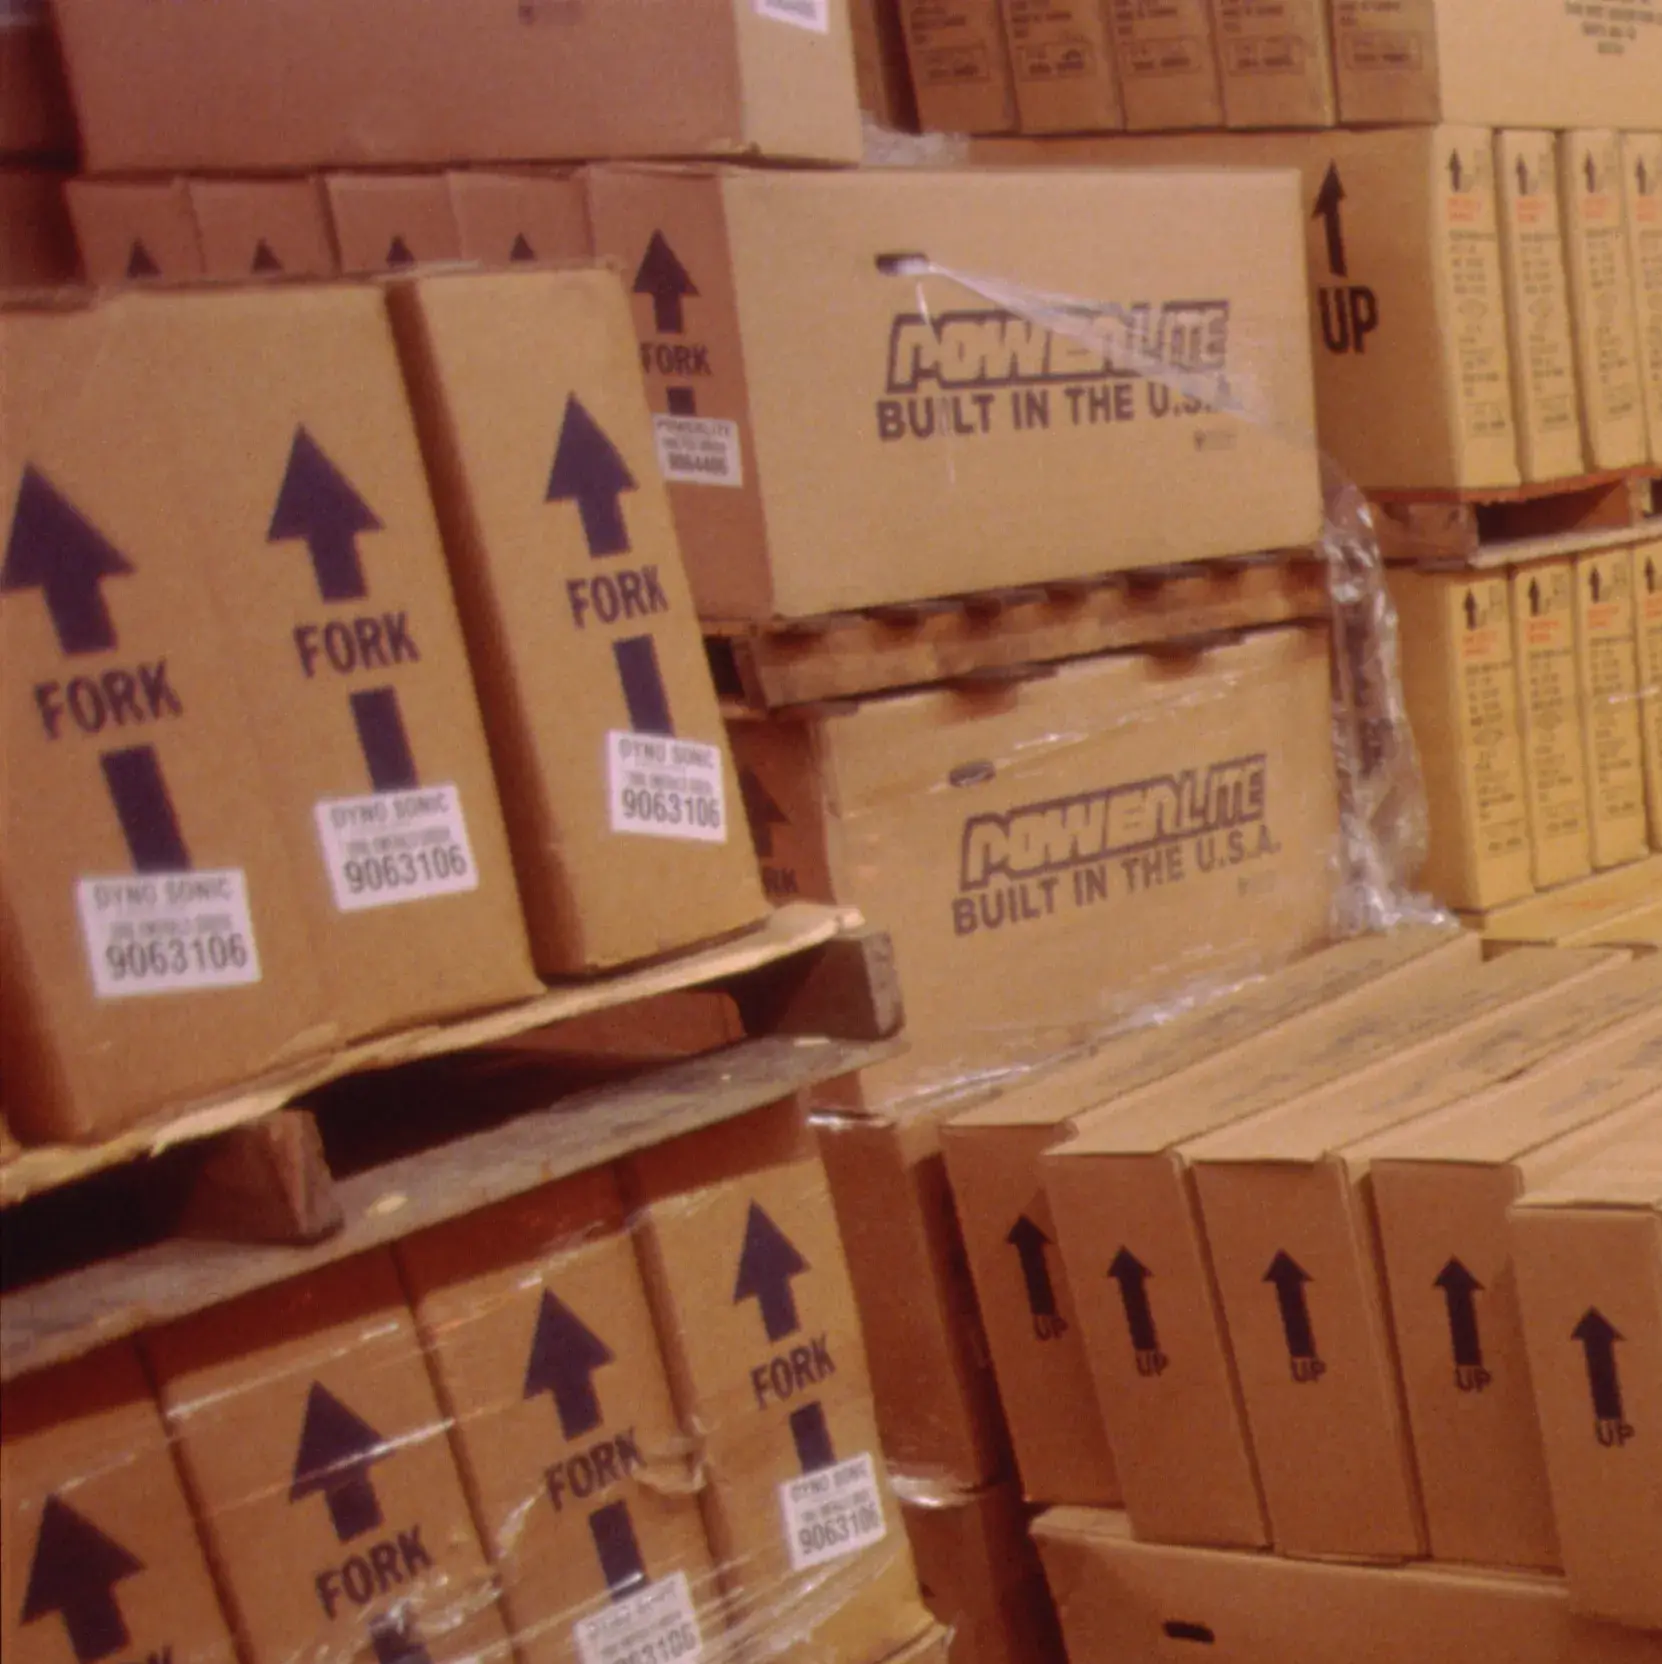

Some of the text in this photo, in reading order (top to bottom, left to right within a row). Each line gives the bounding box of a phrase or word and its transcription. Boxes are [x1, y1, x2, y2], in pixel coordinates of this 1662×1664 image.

[1317, 286, 1379, 354] UP
[641, 342, 712, 376] FORK
[876, 383, 1136, 441] BUILT IN THE
[567, 565, 668, 628] FORK
[294, 612, 421, 679] FORK
[35, 661, 182, 740] FORK
[622, 788, 720, 829] 9063106
[344, 845, 466, 893] 9063106
[952, 825, 1281, 936] BUILT IN THE U.S.A.
[106, 933, 247, 981] 9063106
[1034, 1315, 1068, 1342] UP
[750, 1332, 838, 1411] FORK
[1135, 1350, 1169, 1377] UP
[1291, 1356, 1326, 1383] UP
[1456, 1365, 1492, 1393] UP
[1596, 1420, 1635, 1447] UP
[544, 1427, 648, 1511] FORK
[316, 1523, 432, 1619] FORK
